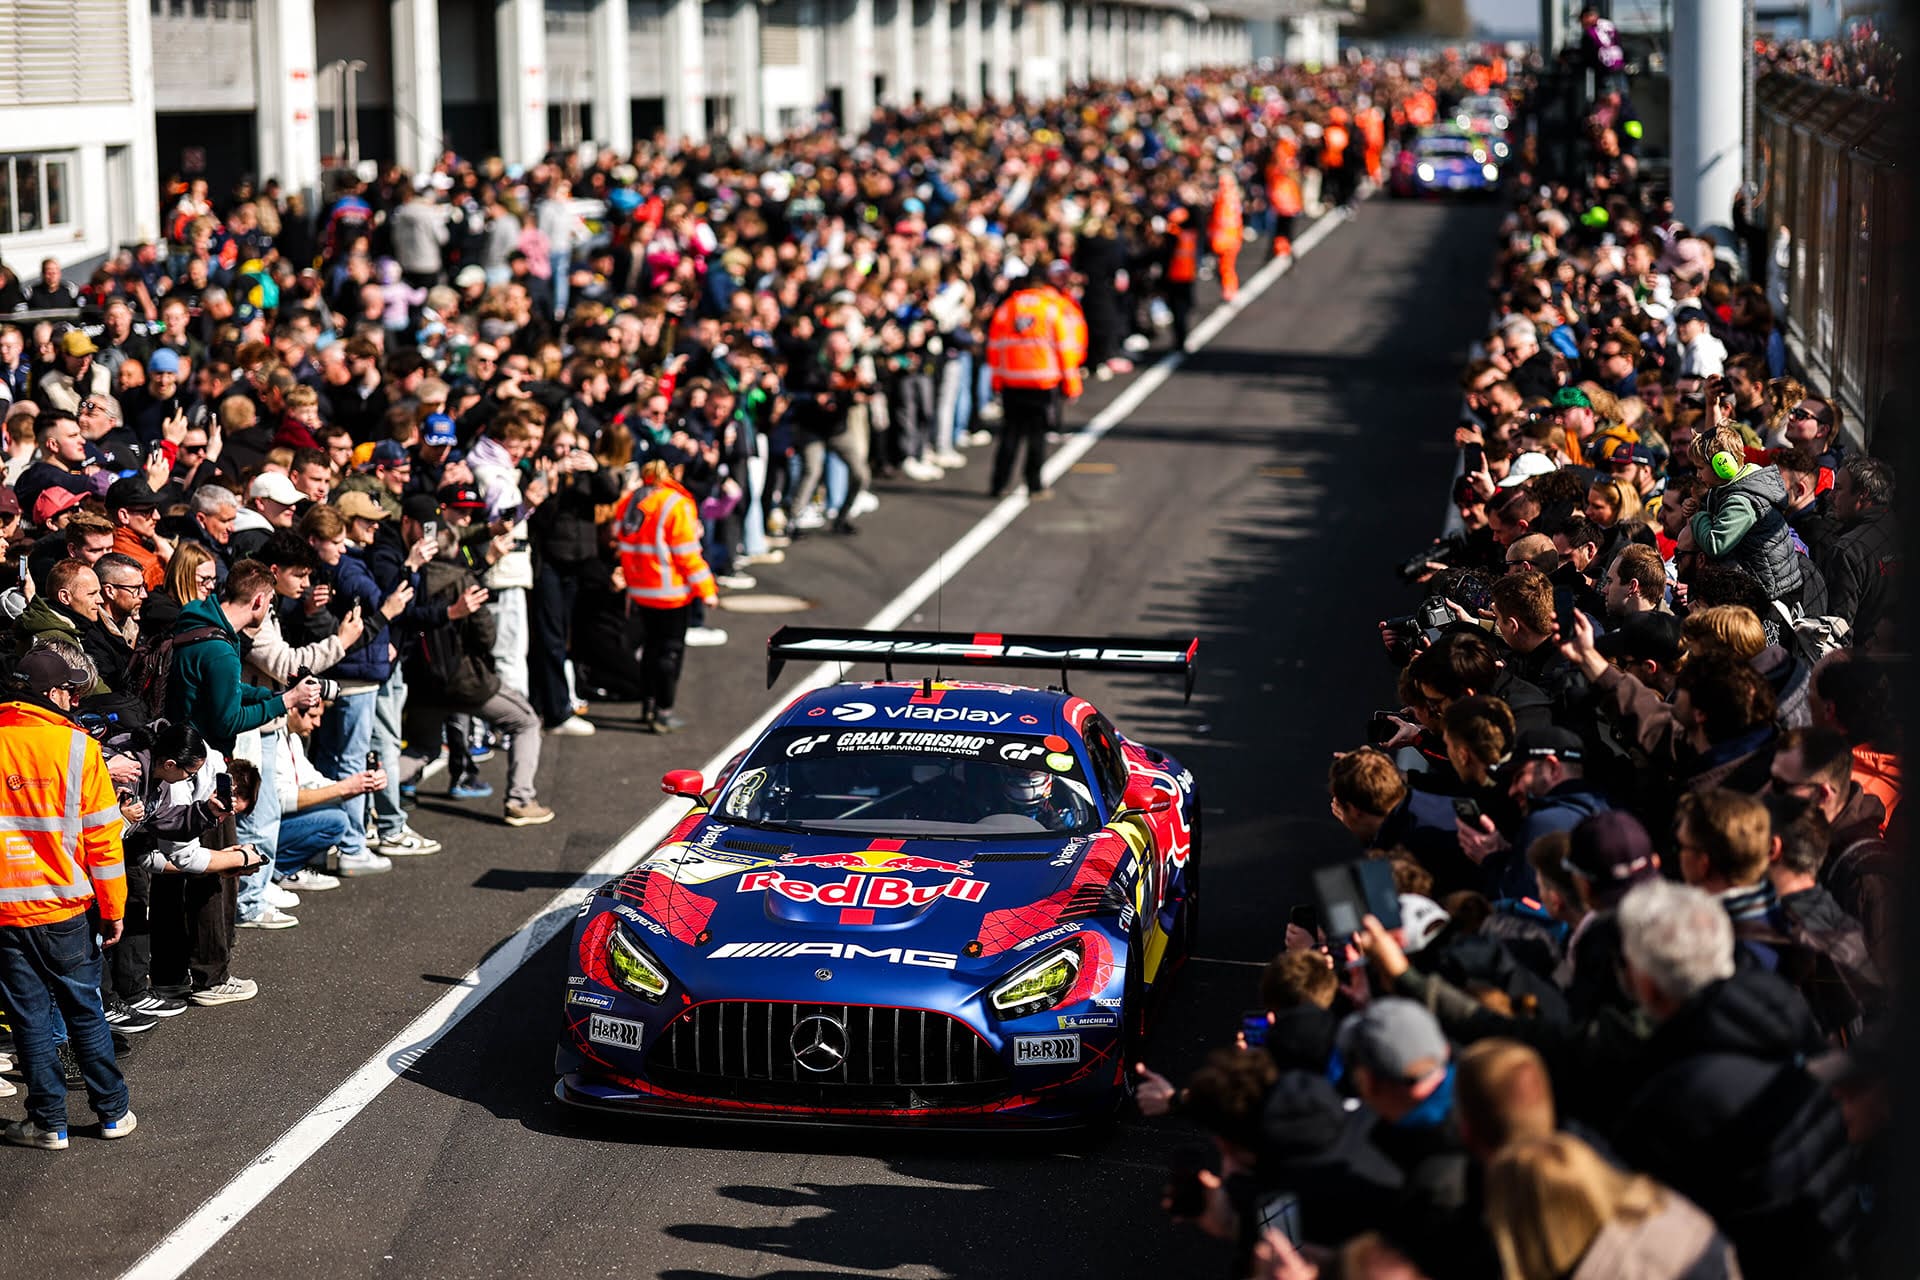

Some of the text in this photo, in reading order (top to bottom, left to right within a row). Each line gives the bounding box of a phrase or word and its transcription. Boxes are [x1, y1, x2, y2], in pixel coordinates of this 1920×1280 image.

[885, 703, 1012, 726] viaplay
[837, 732, 895, 746] GRAN
[924, 745, 979, 756] SIMULATOR
[669, 856, 704, 865] 3
[691, 844, 753, 865] RAVENOL
[736, 871, 990, 909] Red Bull
[784, 942, 957, 970] AMG
[578, 996, 609, 1006] MICHELIN
[592, 1018, 619, 1040] H&R
[1079, 1017, 1114, 1025] MICHELIN
[1020, 1042, 1054, 1059] H&R
